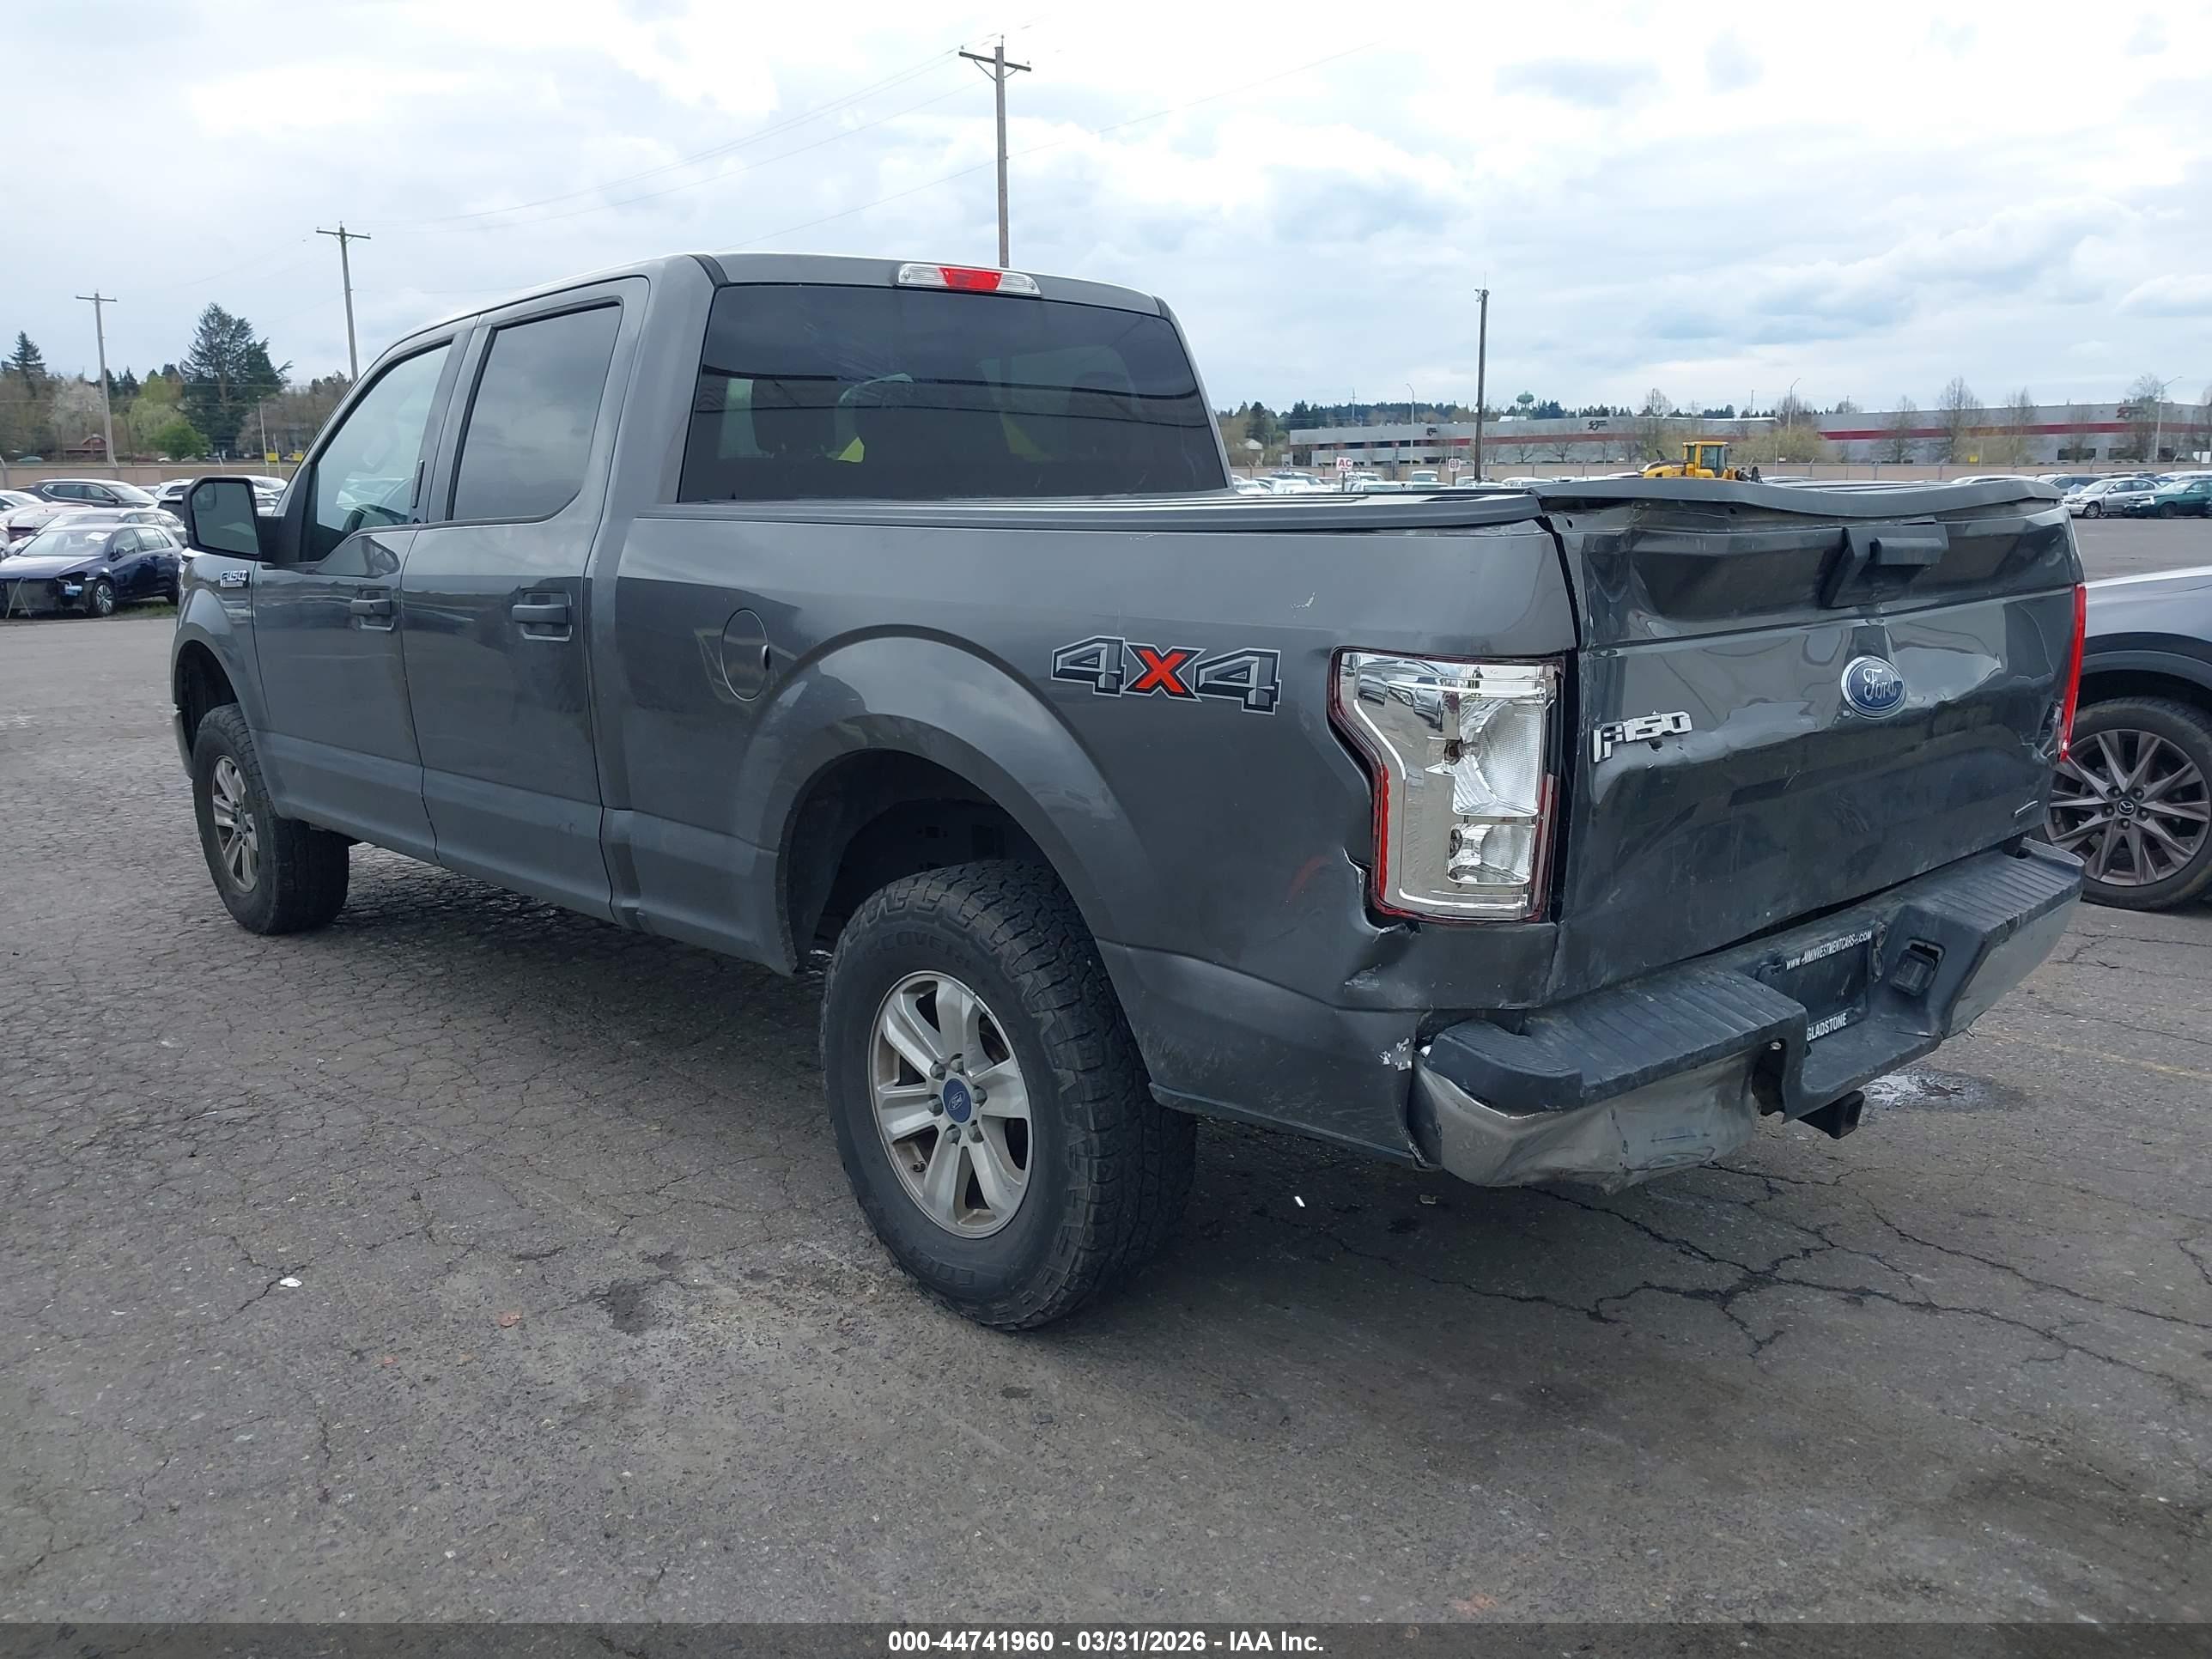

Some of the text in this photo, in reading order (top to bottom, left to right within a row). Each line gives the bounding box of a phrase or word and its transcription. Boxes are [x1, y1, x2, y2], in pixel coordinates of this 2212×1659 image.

[1338, 459, 1352, 468] AC
[1051, 635, 1282, 715] 4X4
[1863, 667, 1897, 702] Ford
[1806, 1012, 1847, 1042] GLADSTONE
